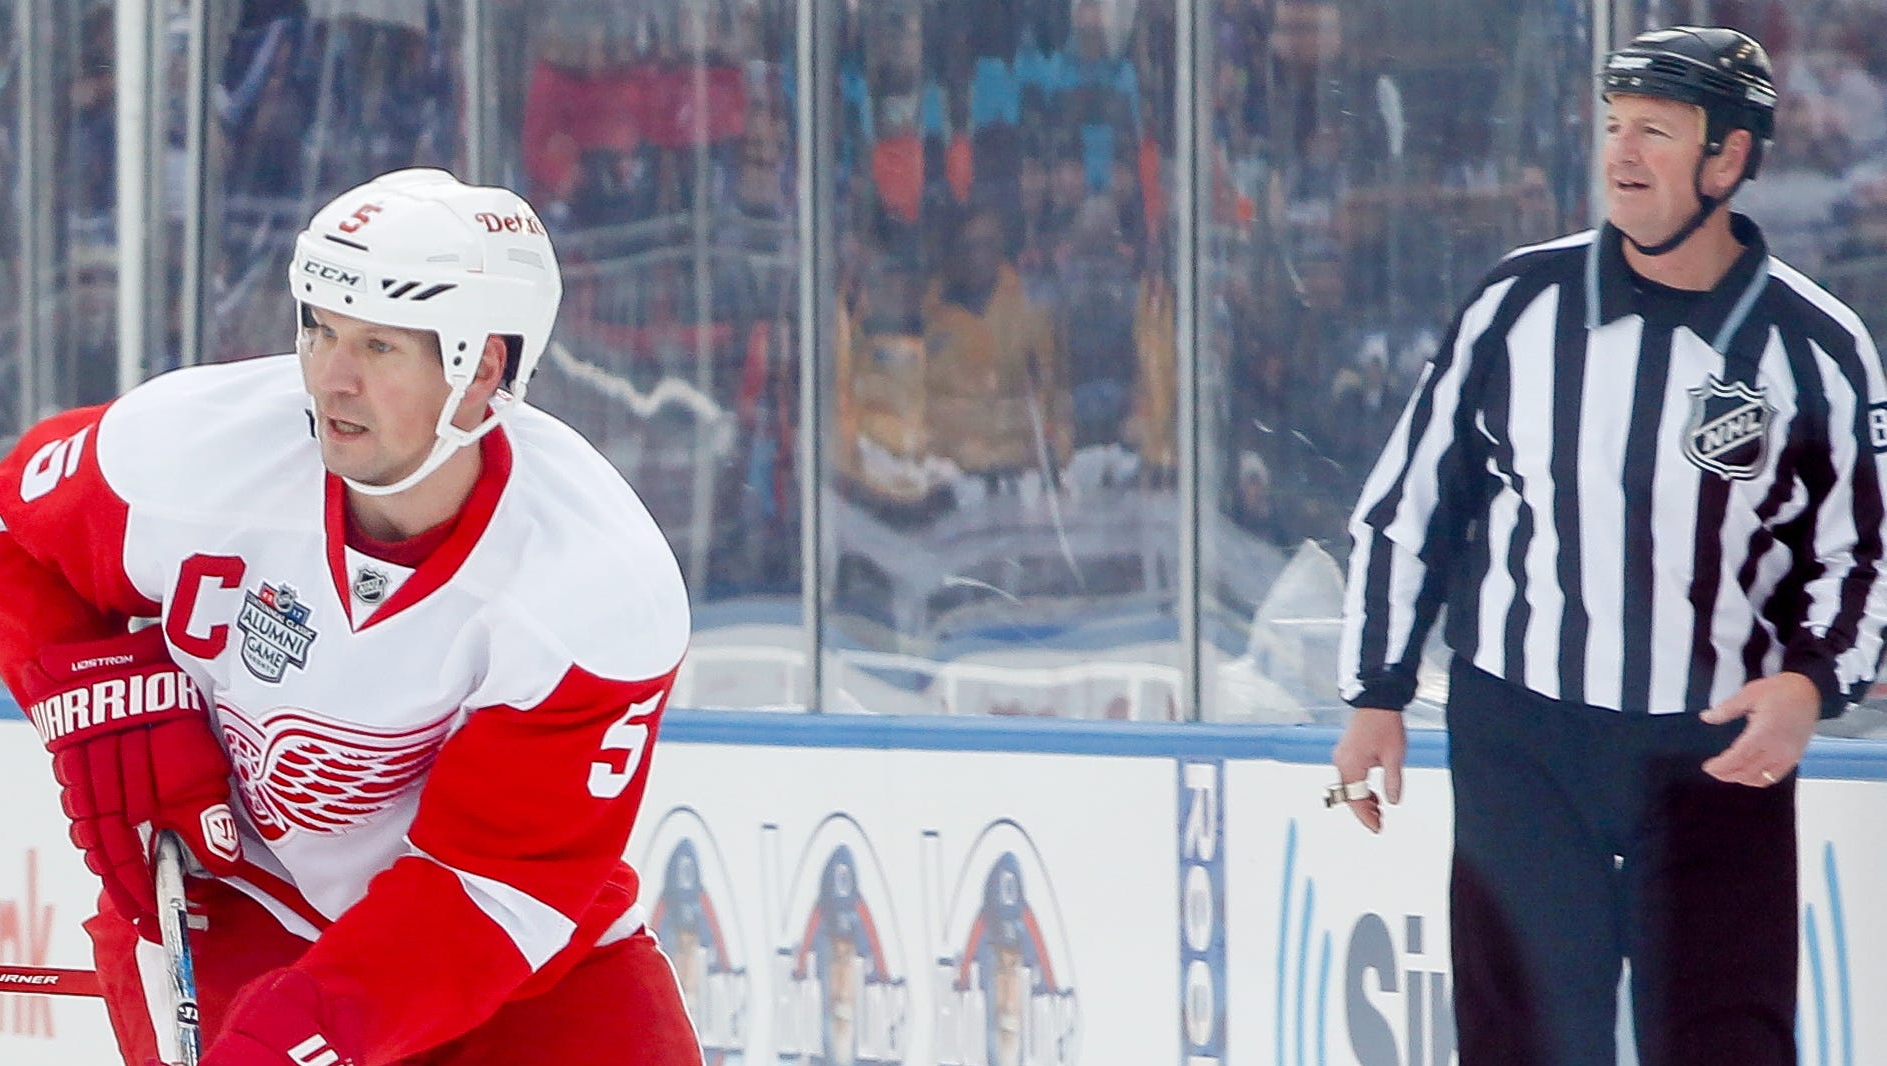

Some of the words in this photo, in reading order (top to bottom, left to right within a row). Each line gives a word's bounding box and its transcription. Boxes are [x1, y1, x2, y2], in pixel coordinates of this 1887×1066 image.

[338, 203, 384, 234] 5
[303, 260, 360, 287] CCM
[1702, 411, 1764, 451] NHL
[20, 424, 93, 502] 5
[166, 553, 246, 660] C
[242, 608, 304, 655] ALUMNI
[247, 636, 283, 669] GAME
[29, 671, 201, 744] WARRIOR
[586, 690, 665, 798] 5
